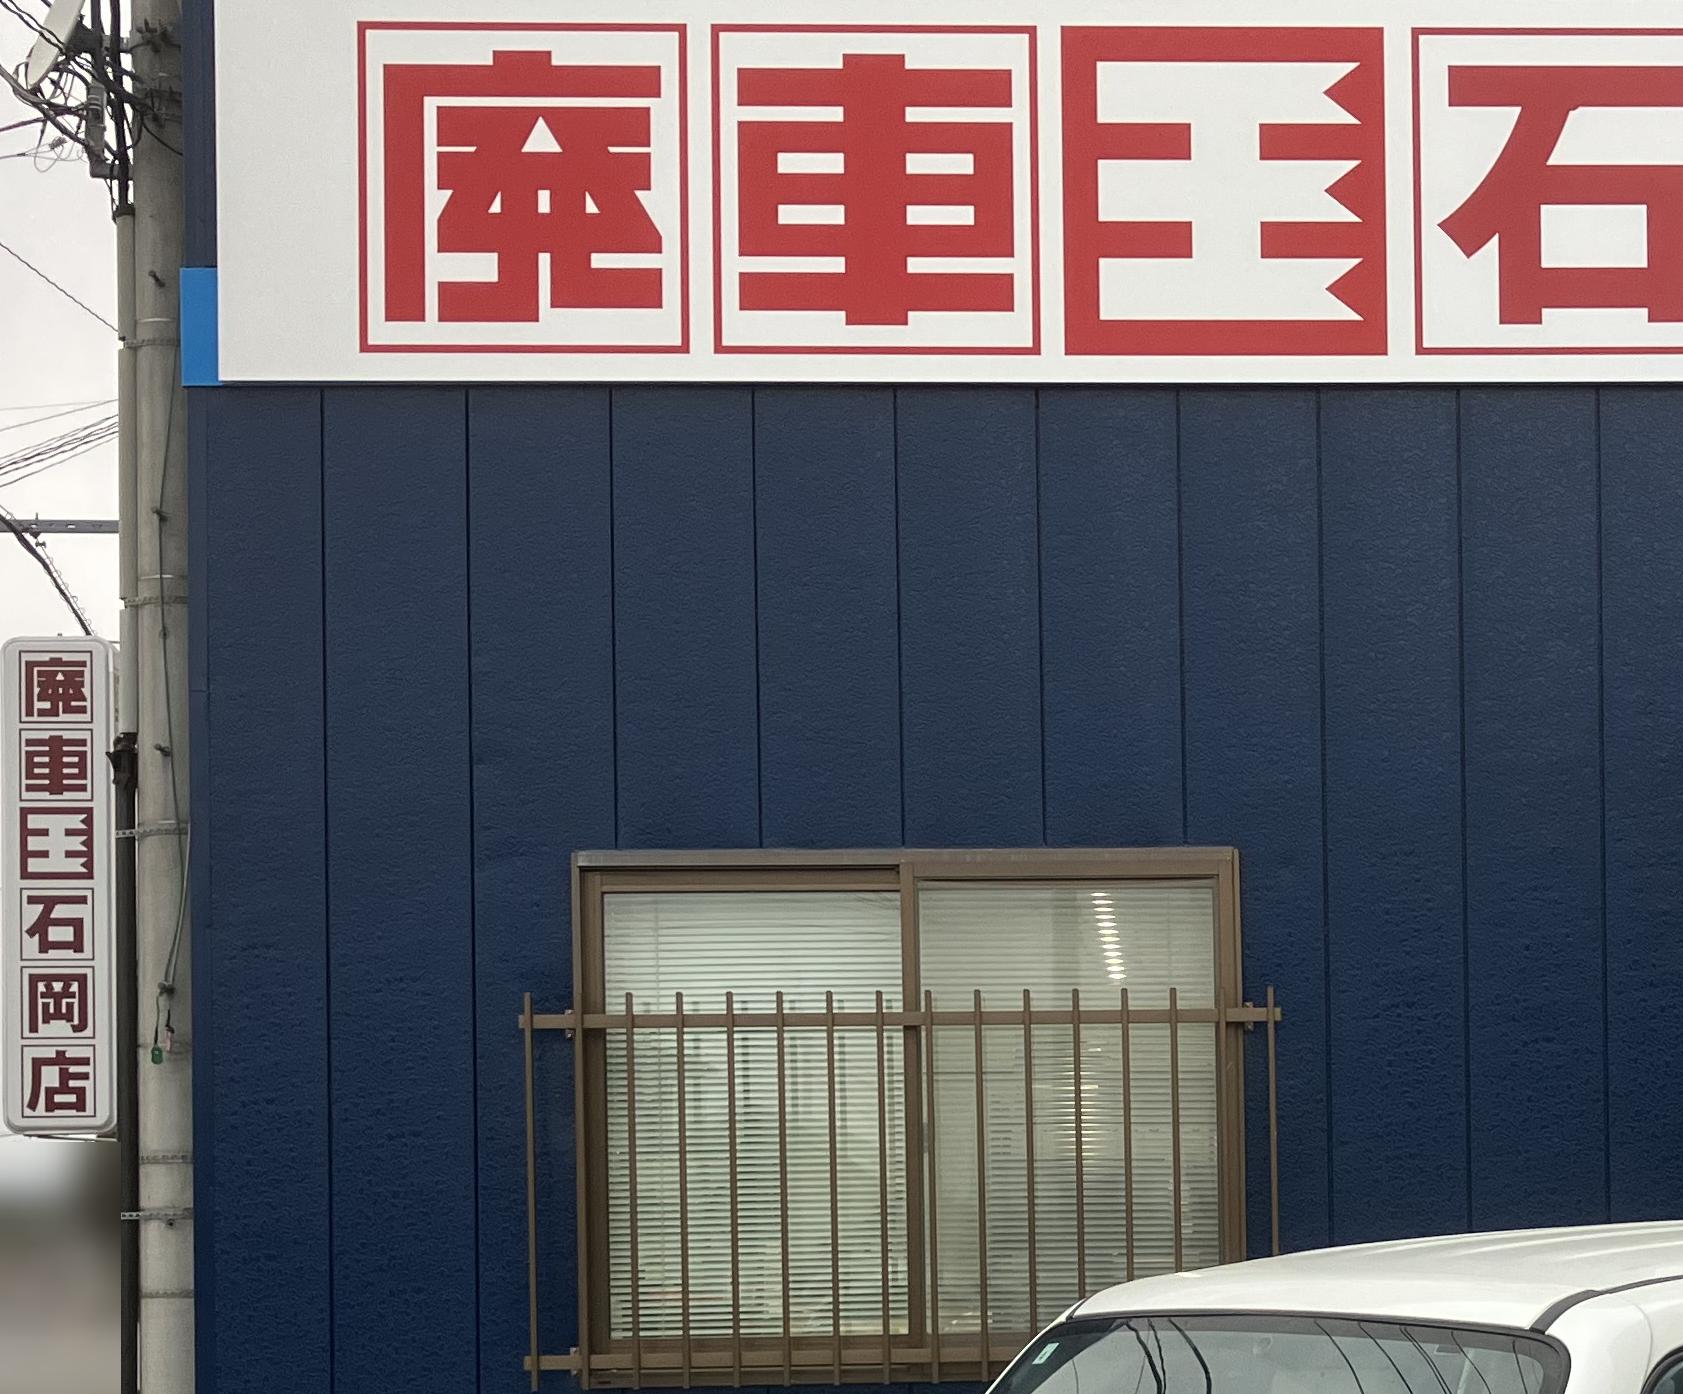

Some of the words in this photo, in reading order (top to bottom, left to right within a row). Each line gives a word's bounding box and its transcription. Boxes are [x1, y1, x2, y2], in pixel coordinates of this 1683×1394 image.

[23, 656, 93, 1114] 廃車王石岡店
